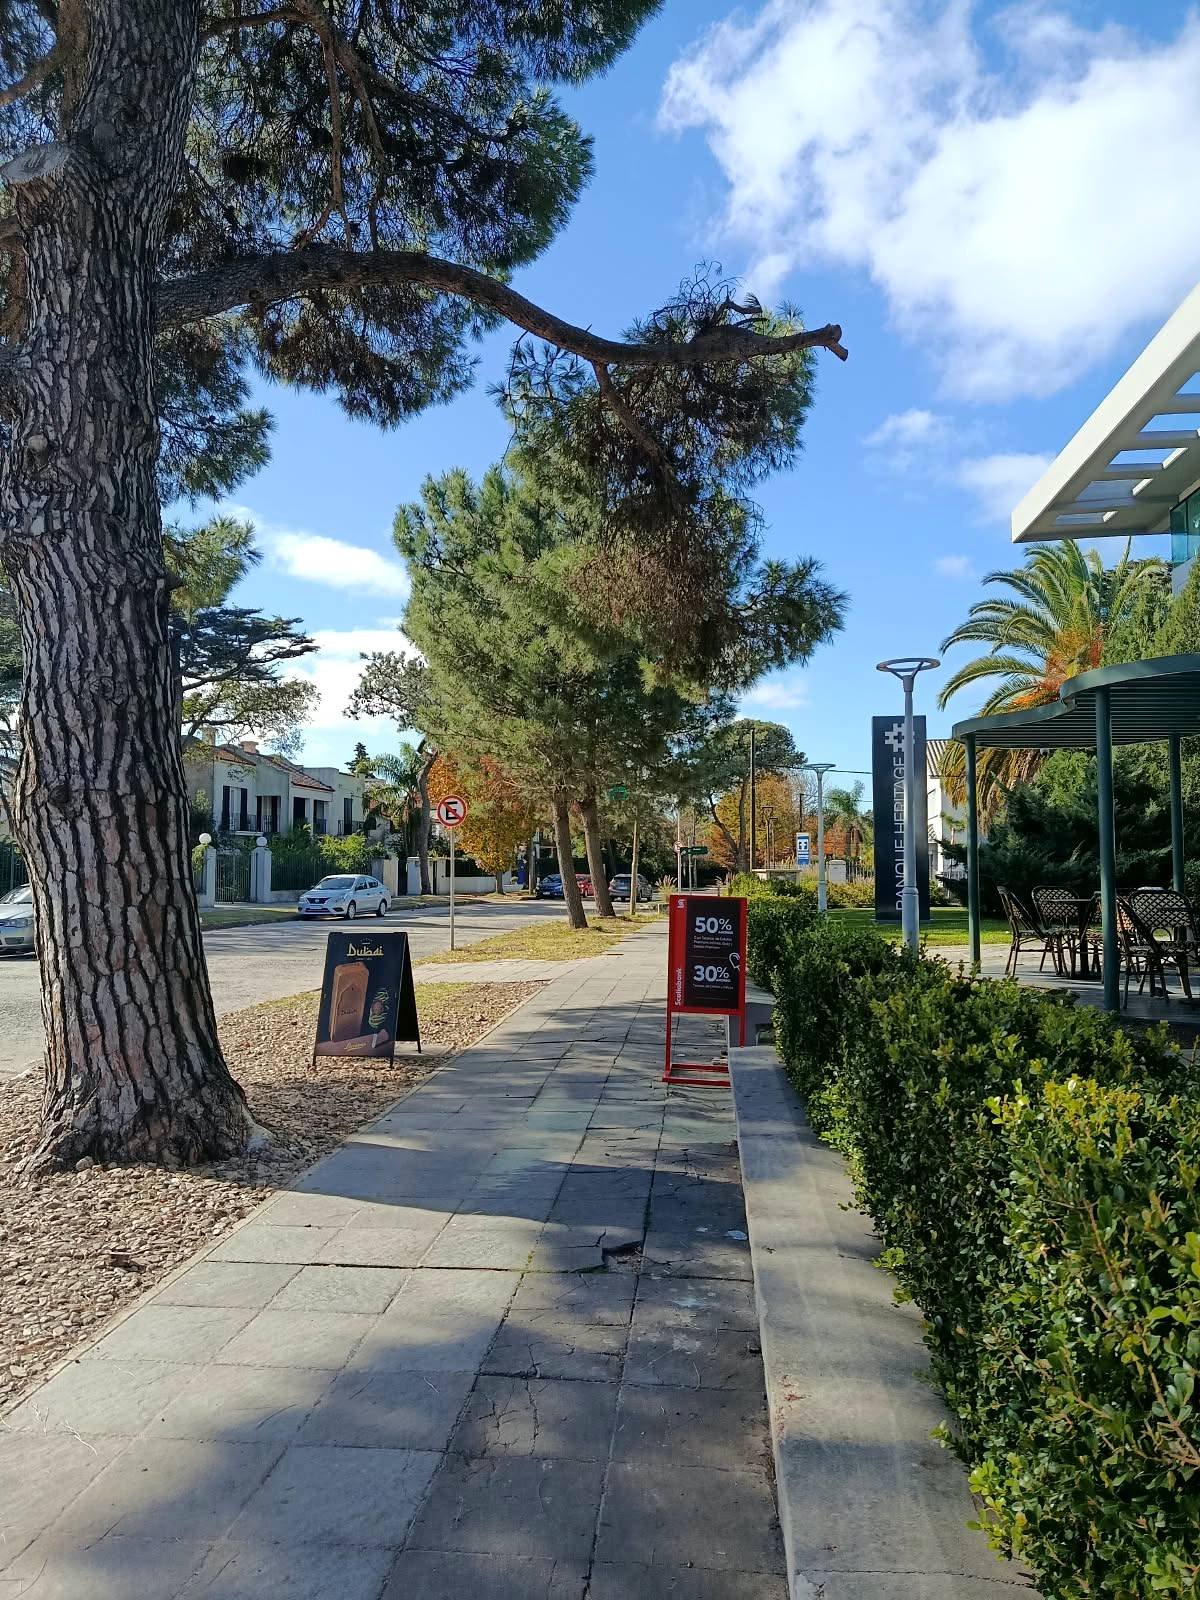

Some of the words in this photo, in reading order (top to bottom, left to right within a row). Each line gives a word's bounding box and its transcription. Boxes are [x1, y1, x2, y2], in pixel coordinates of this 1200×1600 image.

[893, 757, 904, 834] HERITAGE
[445, 801, 458, 820] E
[695, 917, 732, 933] 50%
[346, 943, 384, 956] Dubai
[693, 965, 730, 982] 30%
[674, 967, 682, 1006] Scotiabank
